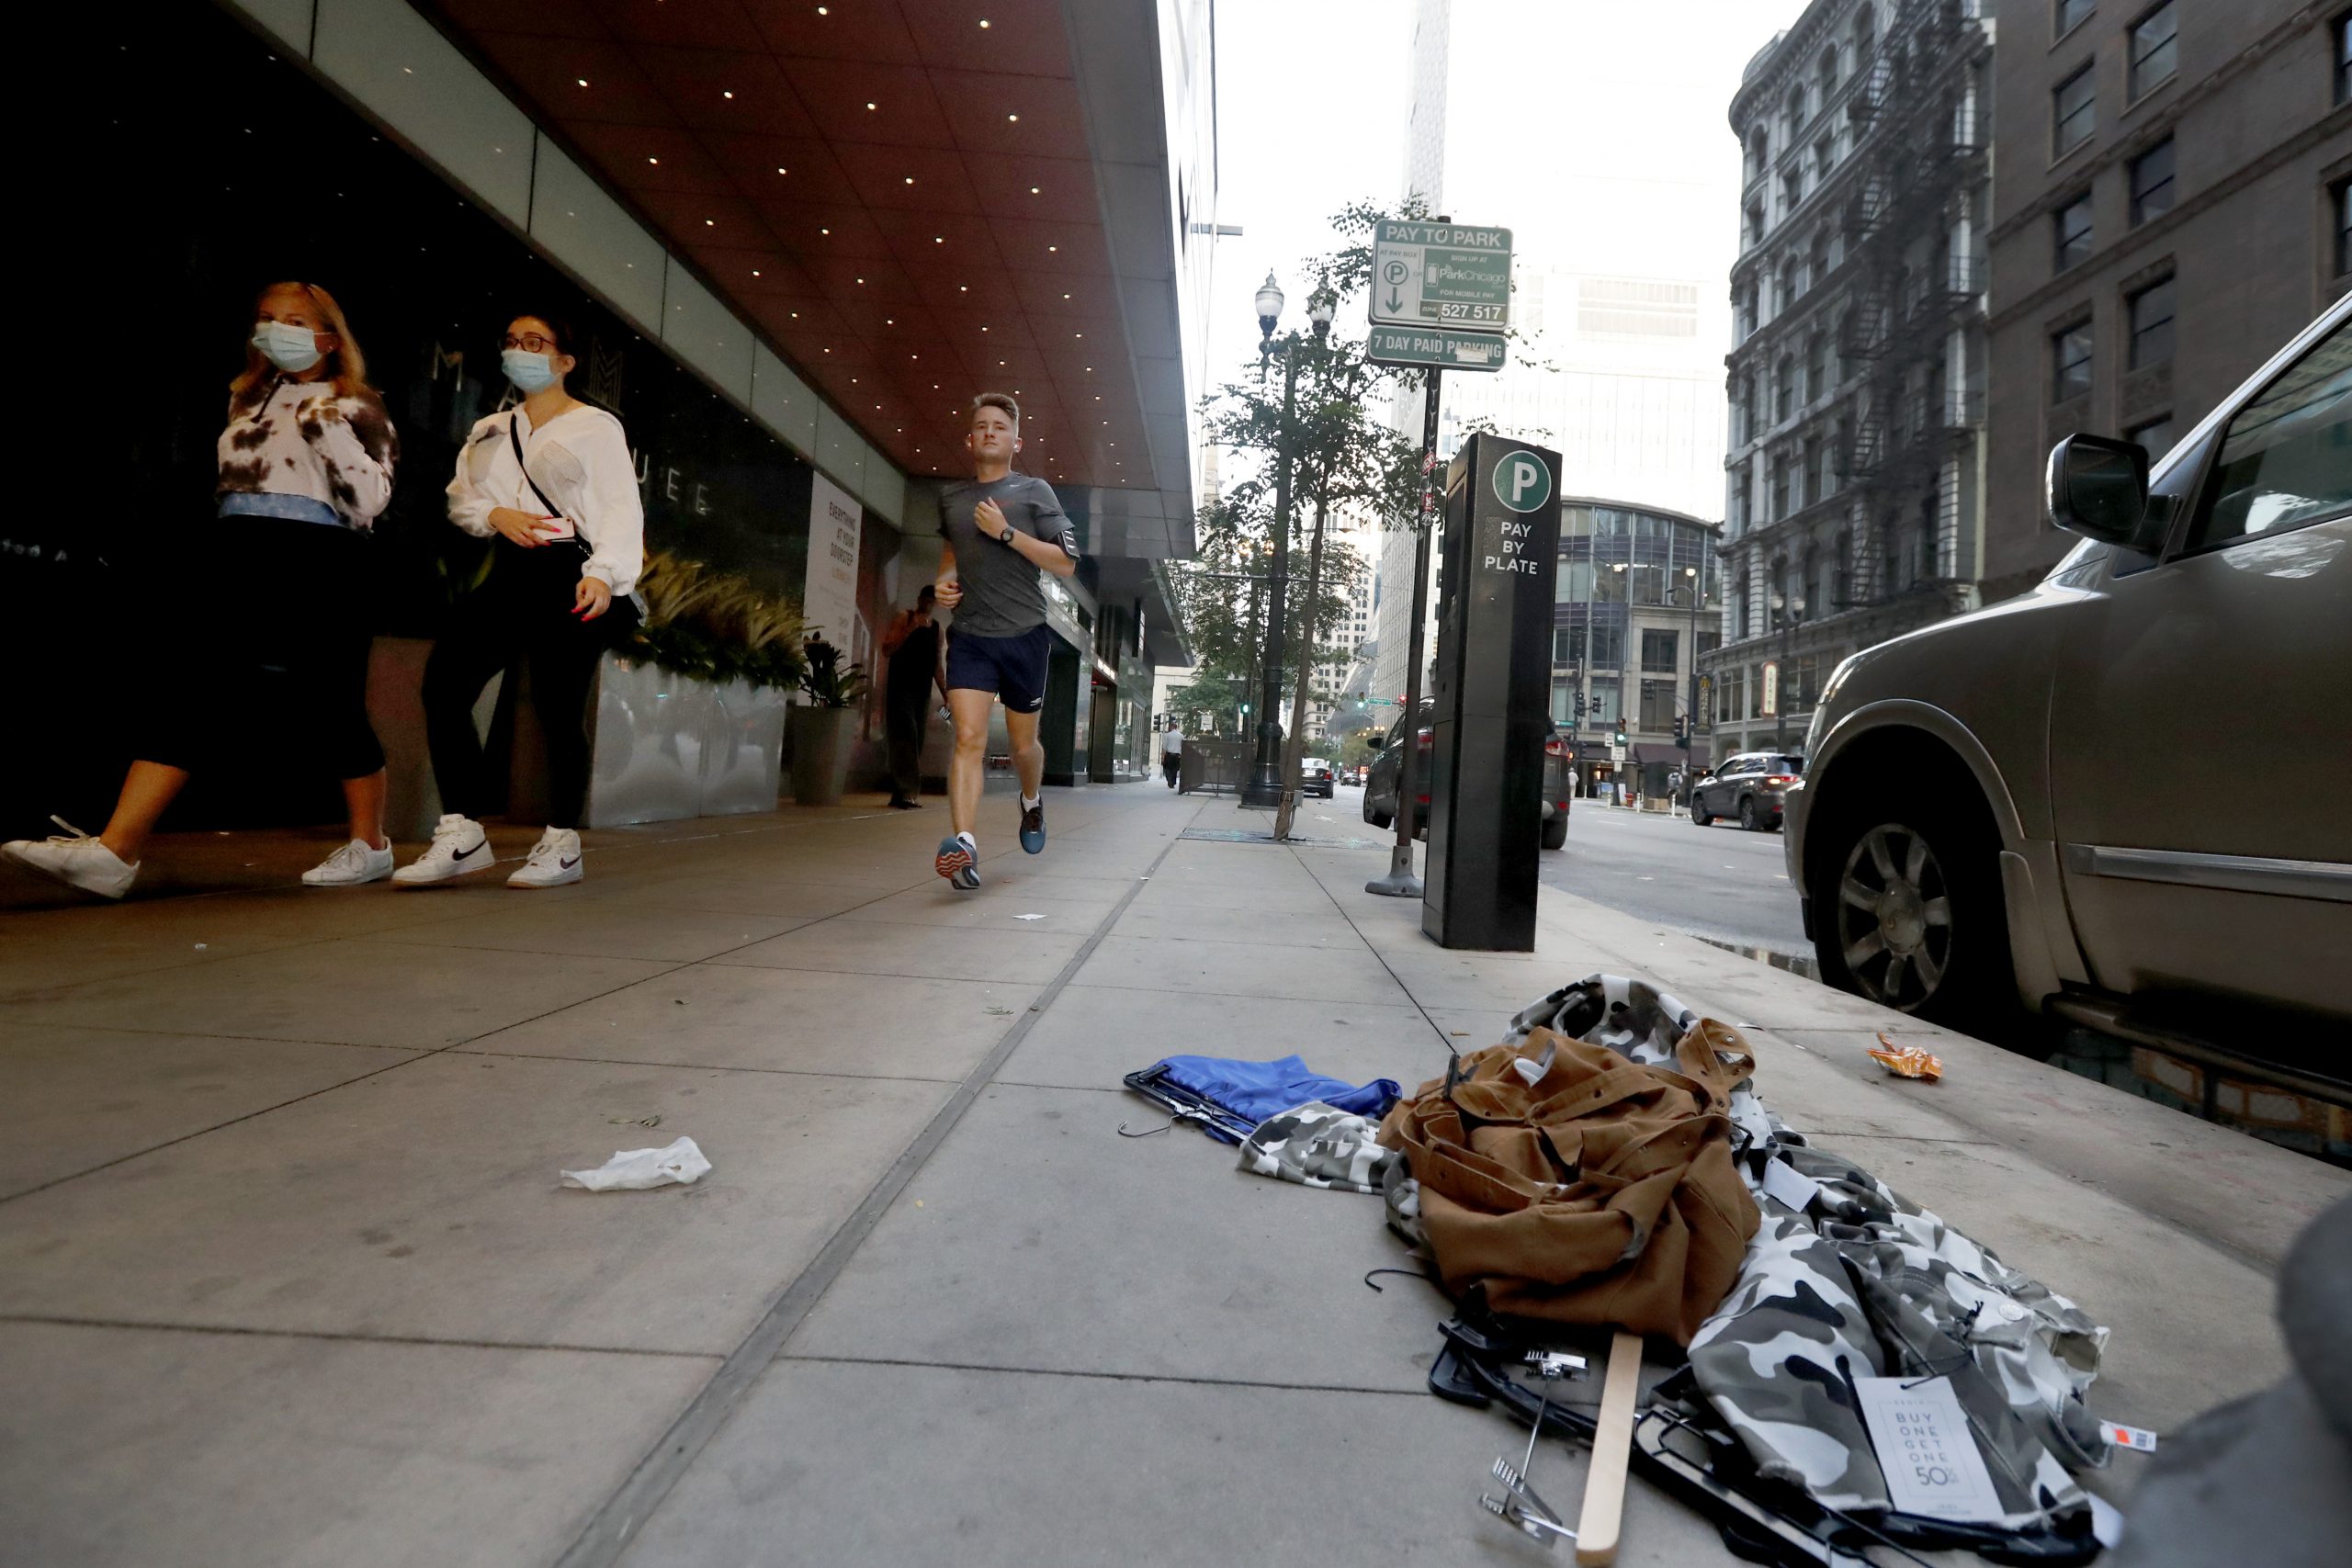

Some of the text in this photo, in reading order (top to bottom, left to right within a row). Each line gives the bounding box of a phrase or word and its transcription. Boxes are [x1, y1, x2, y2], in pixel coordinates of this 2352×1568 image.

[1386, 225, 1501, 247] PAY TO PARK
[1390, 264, 1404, 280] P
[1439, 268, 1506, 284] ParkChicago
[1441, 304, 1469, 318] 527
[1474, 305, 1501, 320] 517
[1374, 335, 1382, 348] 7
[1386, 335, 1410, 351] DAY
[1414, 337, 1443, 353] PAID
[1512, 461, 1538, 502] P
[1500, 521, 1532, 538] PAY
[1502, 540, 1525, 555] BY
[1485, 555, 1538, 575] PLATE
[1895, 1412, 1932, 1424] BUY
[1899, 1426, 1939, 1438] ONE
[1905, 1439, 1942, 1450] GET
[1908, 1452, 1949, 1463] ONE
